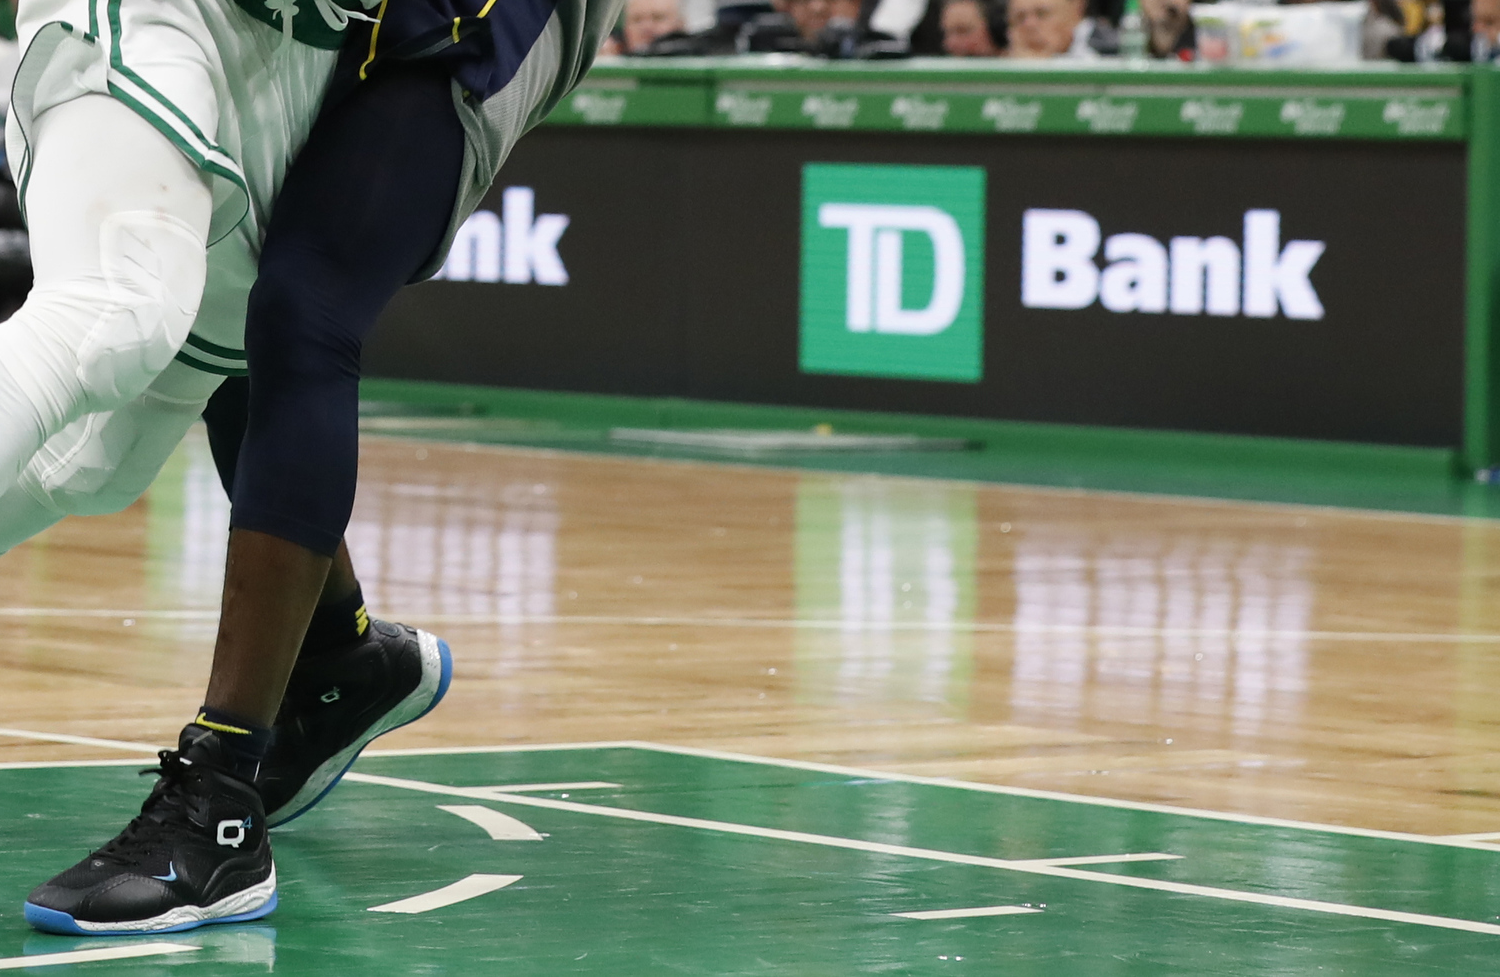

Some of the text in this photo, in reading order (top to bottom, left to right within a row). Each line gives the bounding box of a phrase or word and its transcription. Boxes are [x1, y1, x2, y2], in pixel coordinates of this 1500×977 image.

[429, 185, 570, 286] nk
[819, 203, 1324, 335] TD Bank
